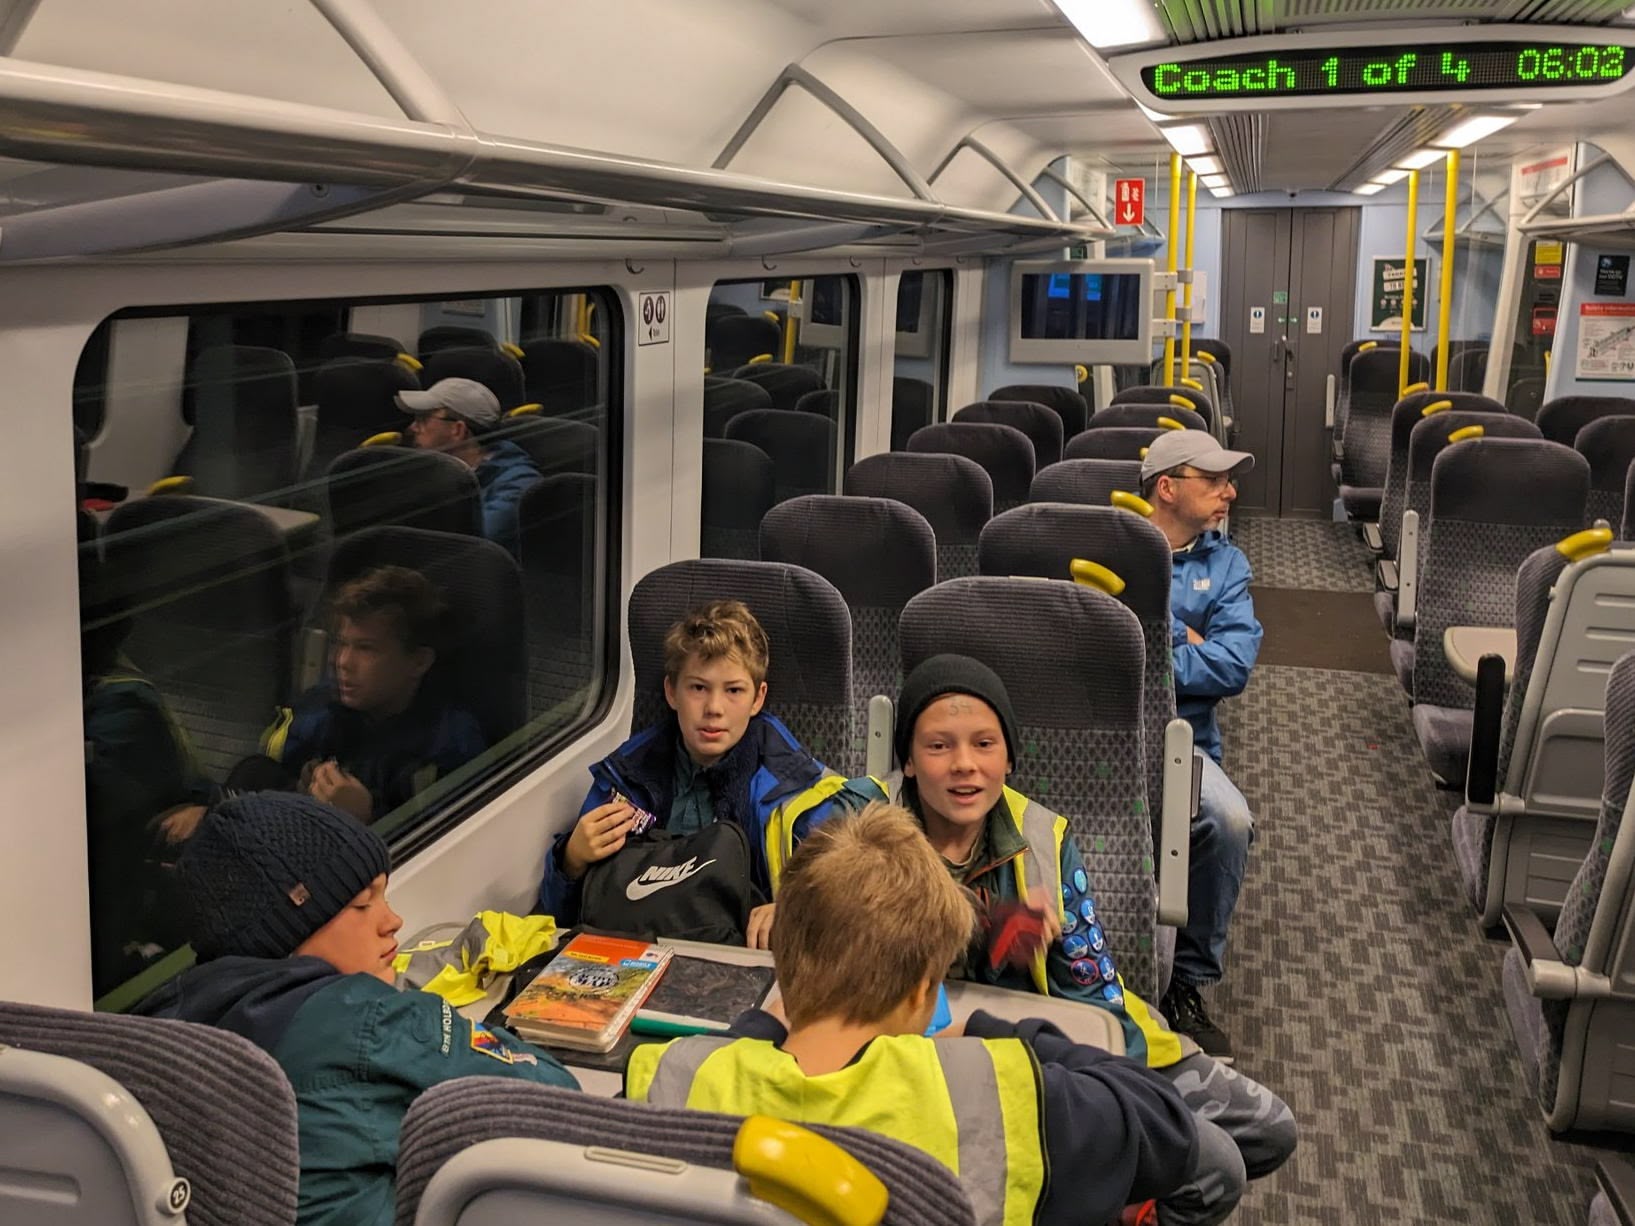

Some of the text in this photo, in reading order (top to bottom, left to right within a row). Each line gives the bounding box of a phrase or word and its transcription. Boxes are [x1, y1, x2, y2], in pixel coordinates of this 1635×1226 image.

[1155, 46, 1625, 93] Coach 1 of 4 06:02
[638, 856, 698, 882] NIKE
[173, 1184, 186, 1205] 25
